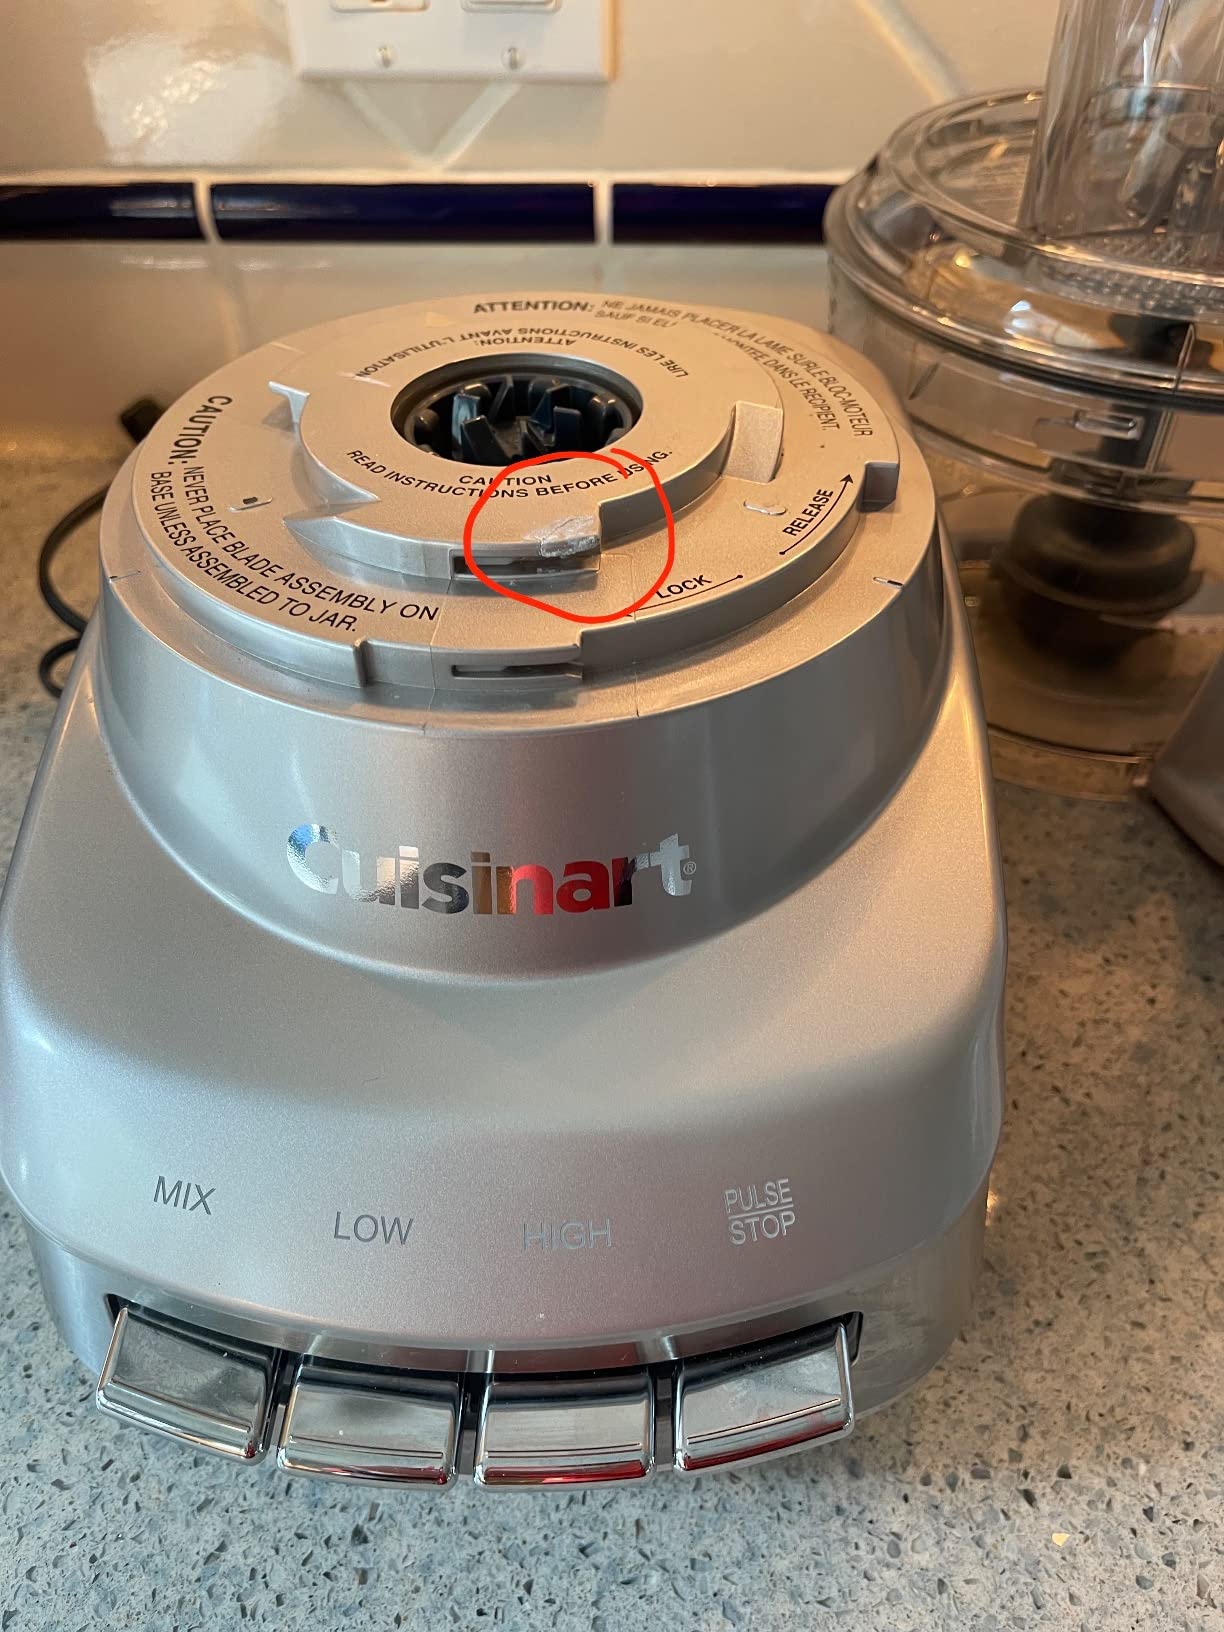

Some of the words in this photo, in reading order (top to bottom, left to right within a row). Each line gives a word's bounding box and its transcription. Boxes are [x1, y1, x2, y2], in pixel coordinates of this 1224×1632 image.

[459, 328, 513, 342] AVANT
[475, 337, 577, 346] ATTENTION:
[518, 328, 638, 350] INSTRUCTIONS
[473, 300, 595, 313] ATTENTION:
[601, 300, 623, 309] NE
[625, 303, 682, 318] JAMAIS
[681, 313, 740, 333] PLACER
[754, 336, 794, 355] LAME
[818, 376, 873, 436] BLOC-MOTEUR
[636, 346, 665, 361] LES
[660, 359, 689, 378] LIRE
[763, 359, 799, 379] DANS
[789, 377, 811, 389] LE
[168, 395, 233, 466] CAUTION:
[150, 471, 174, 502] BASE
[183, 466, 210, 506] NEVER
[347, 450, 386, 474] READ
[536, 473, 618, 497] BEFORE
[617, 450, 673, 478] USNG.
[154, 501, 197, 547] UNLESS
[191, 505, 236, 544] PLACE
[782, 488, 834, 537] RELEASE
[180, 545, 280, 605] ASSEMBLED
[222, 540, 284, 578] BLADE
[274, 572, 398, 614] ASSEMBLY
[655, 574, 713, 599] LOCK
[278, 597, 311, 617] TO
[308, 609, 358, 632] JAR.
[399, 604, 439, 621] ON
[153, 1175, 216, 1216] MIX
[724, 1177, 793, 1213] PULSE
[333, 1211, 414, 1246] LOW
[523, 1218, 612, 1250] HIGH
[729, 1210, 796, 1246] STOP
